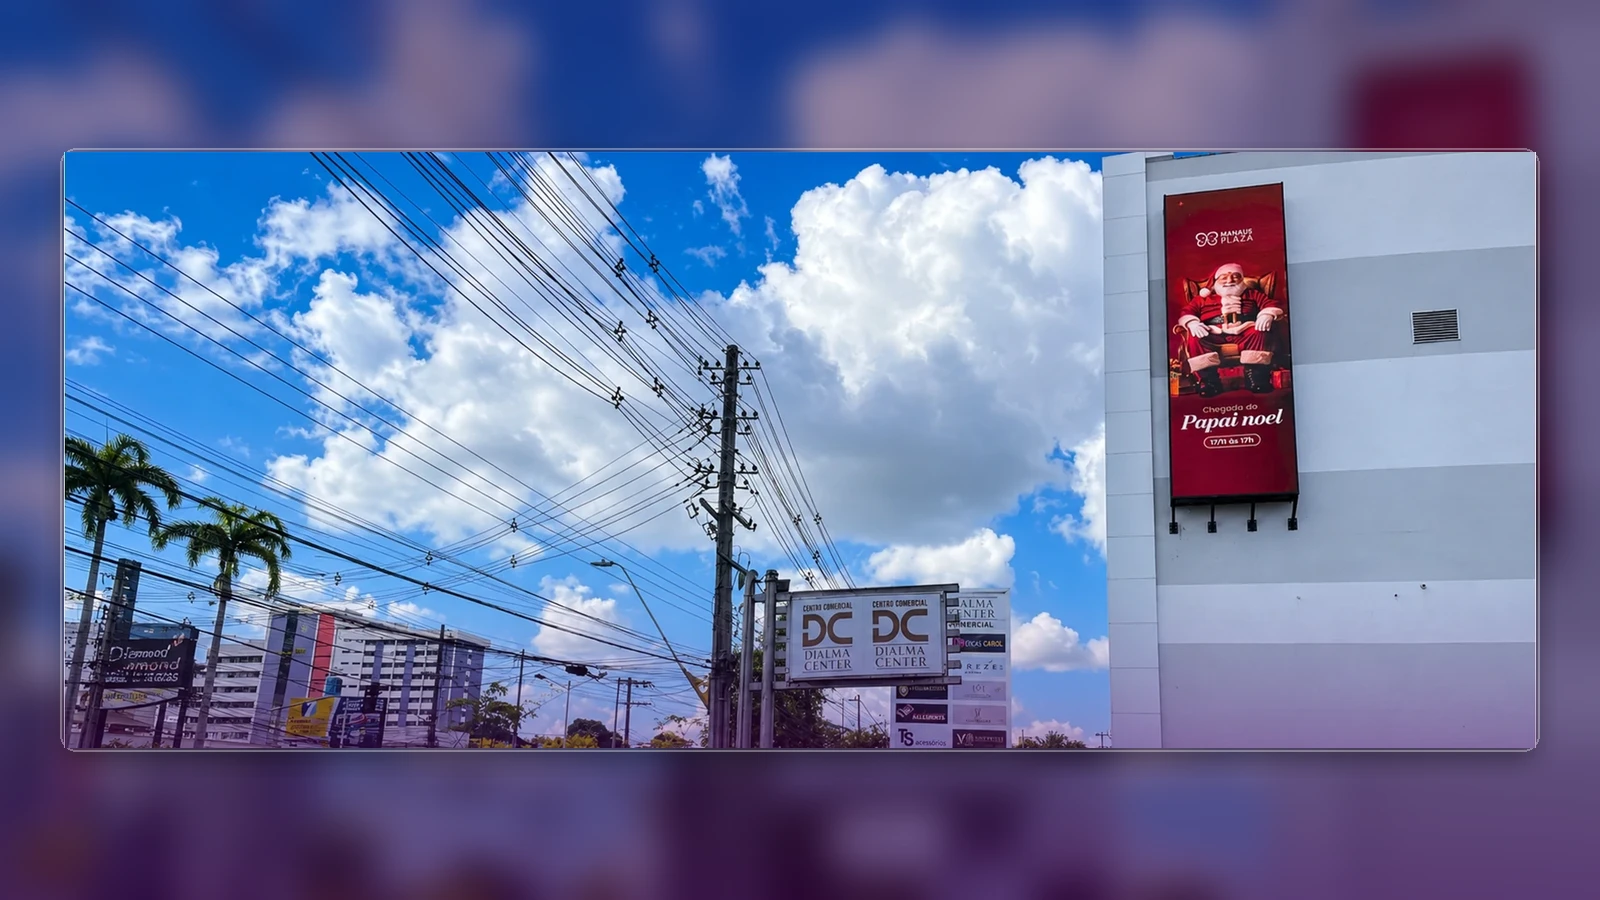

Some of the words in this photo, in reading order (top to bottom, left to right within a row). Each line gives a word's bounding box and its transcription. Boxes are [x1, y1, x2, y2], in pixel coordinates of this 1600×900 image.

[1220, 228, 1253, 237] MANAUS
[1220, 234, 1254, 244] PLAZA
[1202, 404, 1244, 414] Chegada
[1180, 412, 1239, 433] Papai
[1241, 408, 1283, 426] noel
[1210, 438, 1227, 446] 17/11
[1240, 436, 1254, 444] 17h
[803, 604, 822, 612] CENTRO
[872, 600, 893, 608] CENTRO
[895, 599, 928, 607] COMERCIAL
[802, 612, 853, 647] DC
[872, 609, 929, 643] DC
[804, 648, 851, 661] DIALMA
[875, 645, 925, 657] DIALMA
[804, 659, 852, 671] CENTER
[875, 656, 927, 668] CENTER
[898, 728, 914, 746] TS
[915, 739, 947, 747] acessórios
